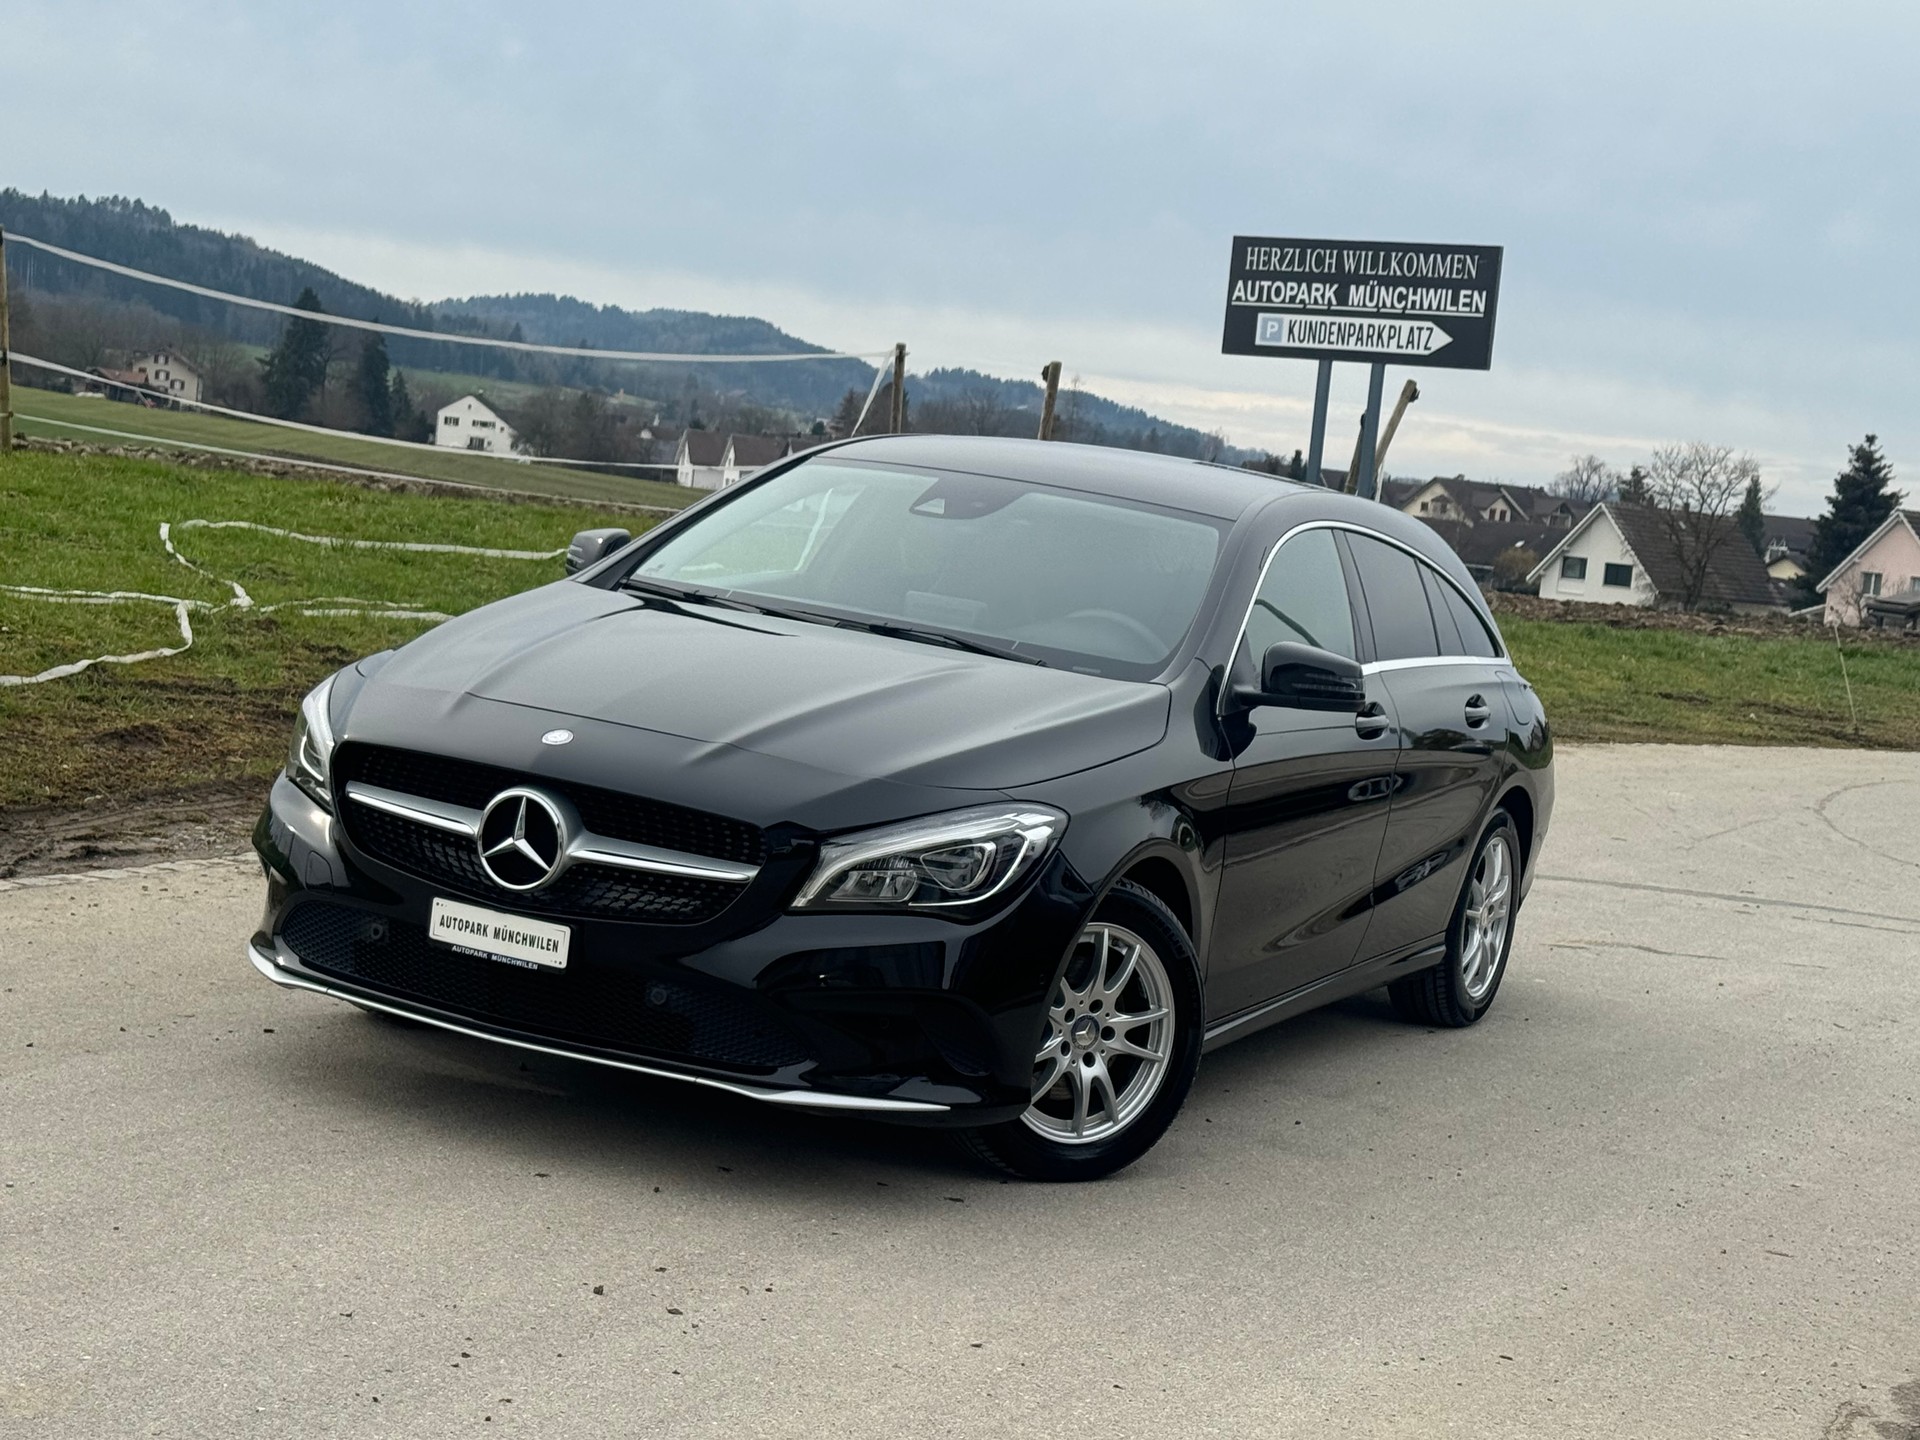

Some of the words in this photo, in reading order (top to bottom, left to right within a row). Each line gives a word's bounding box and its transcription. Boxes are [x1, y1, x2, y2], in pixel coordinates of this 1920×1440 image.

[1245, 246, 1338, 274] HERZLICH
[1343, 249, 1480, 280] WILLKOMMEN
[1231, 279, 1339, 306] AUTOPARK
[1348, 280, 1487, 313] MÜNCHWILEN
[1265, 320, 1279, 338] P
[1287, 318, 1435, 352] KUNDENPARKPLATZ
[439, 914, 489, 938] AUTOPARK
[493, 925, 559, 953] MÜNCHWILEN
[452, 945, 488, 959] AUTOPARK
[491, 954, 538, 970] MÜNCHWILEN
